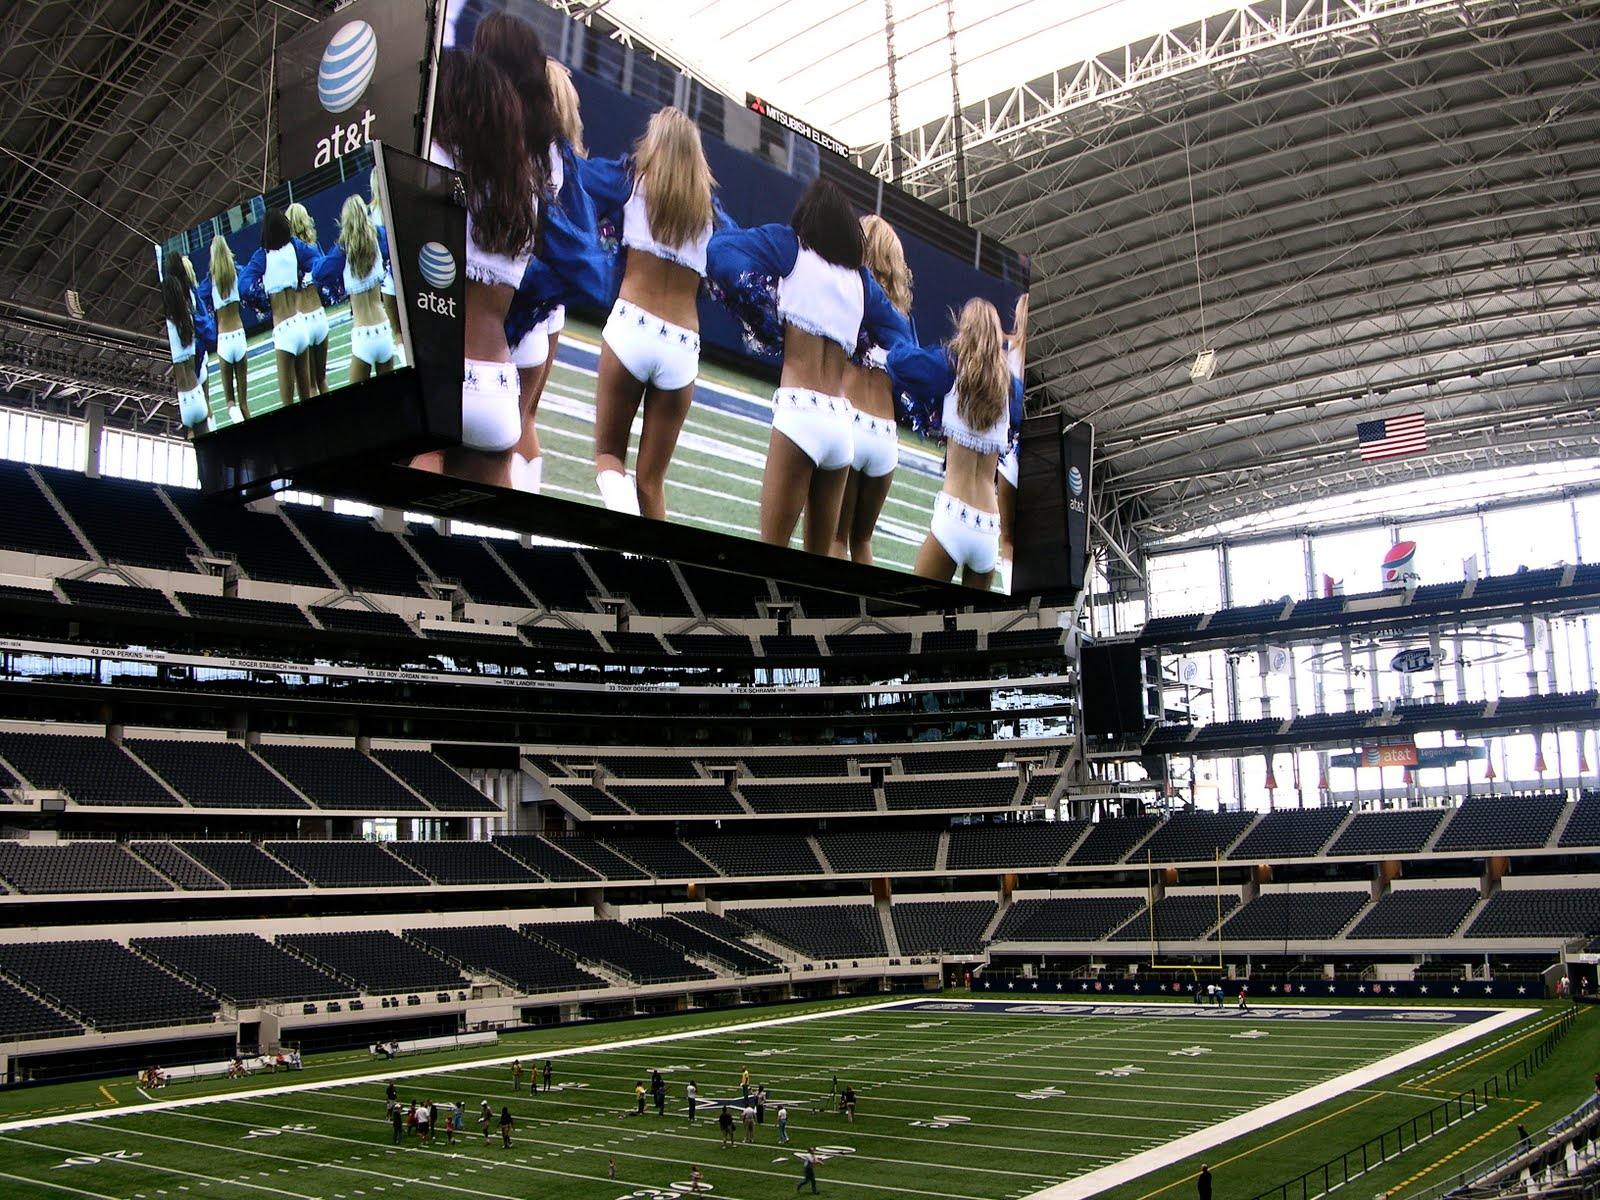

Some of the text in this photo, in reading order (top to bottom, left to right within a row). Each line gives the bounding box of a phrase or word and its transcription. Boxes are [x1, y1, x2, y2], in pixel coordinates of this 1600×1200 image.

[766, 104, 849, 157] MITSUBISHI ELECTRIC
[314, 109, 376, 168] at&t
[417, 291, 457, 318] at&t
[116, 650, 143, 659] PERKINS
[238, 660, 258, 668] ROGER
[259, 662, 287, 670] STAUBACH
[399, 672, 420, 680] JORDAN
[1383, 748, 1411, 762] at&t
